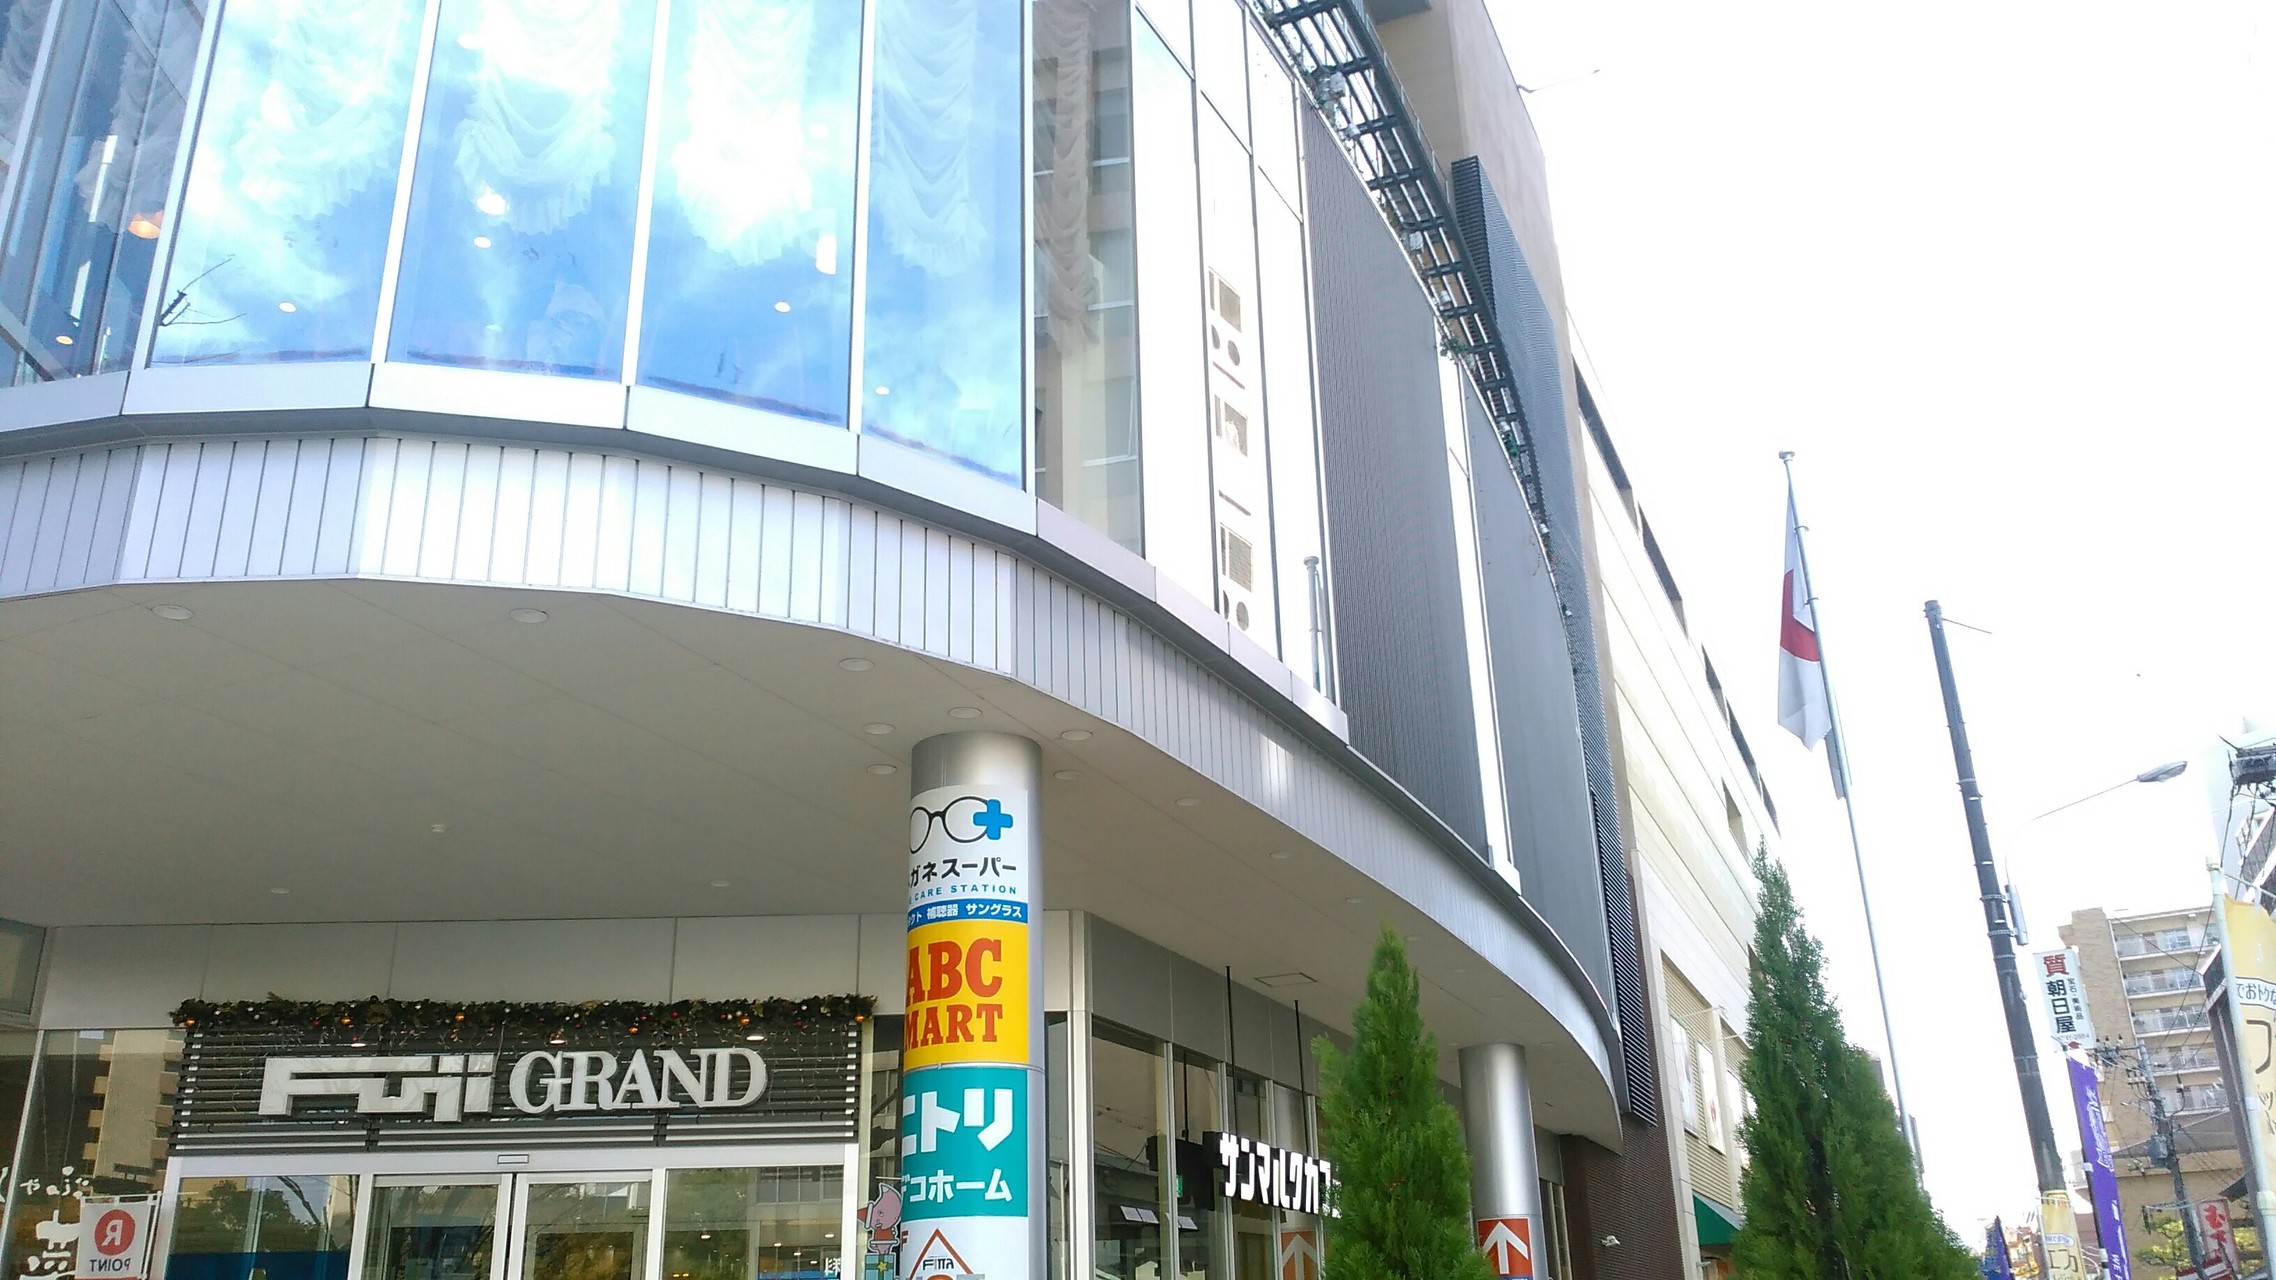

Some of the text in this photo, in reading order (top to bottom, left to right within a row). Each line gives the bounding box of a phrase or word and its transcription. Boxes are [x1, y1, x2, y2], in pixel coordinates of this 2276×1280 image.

[908, 856, 1017, 889] ガネスーパー
[914, 886, 943, 902] CARE
[950, 884, 1017, 896] STATION
[926, 903, 959, 920] 補聴器
[965, 902, 1023, 919] サングラス
[906, 937, 1003, 1008] ABC
[2043, 953, 2070, 978] 質
[2045, 979, 2077, 1034] 朝日屋
[905, 1003, 1003, 1053] MART
[509, 1049, 769, 1114] GRAND
